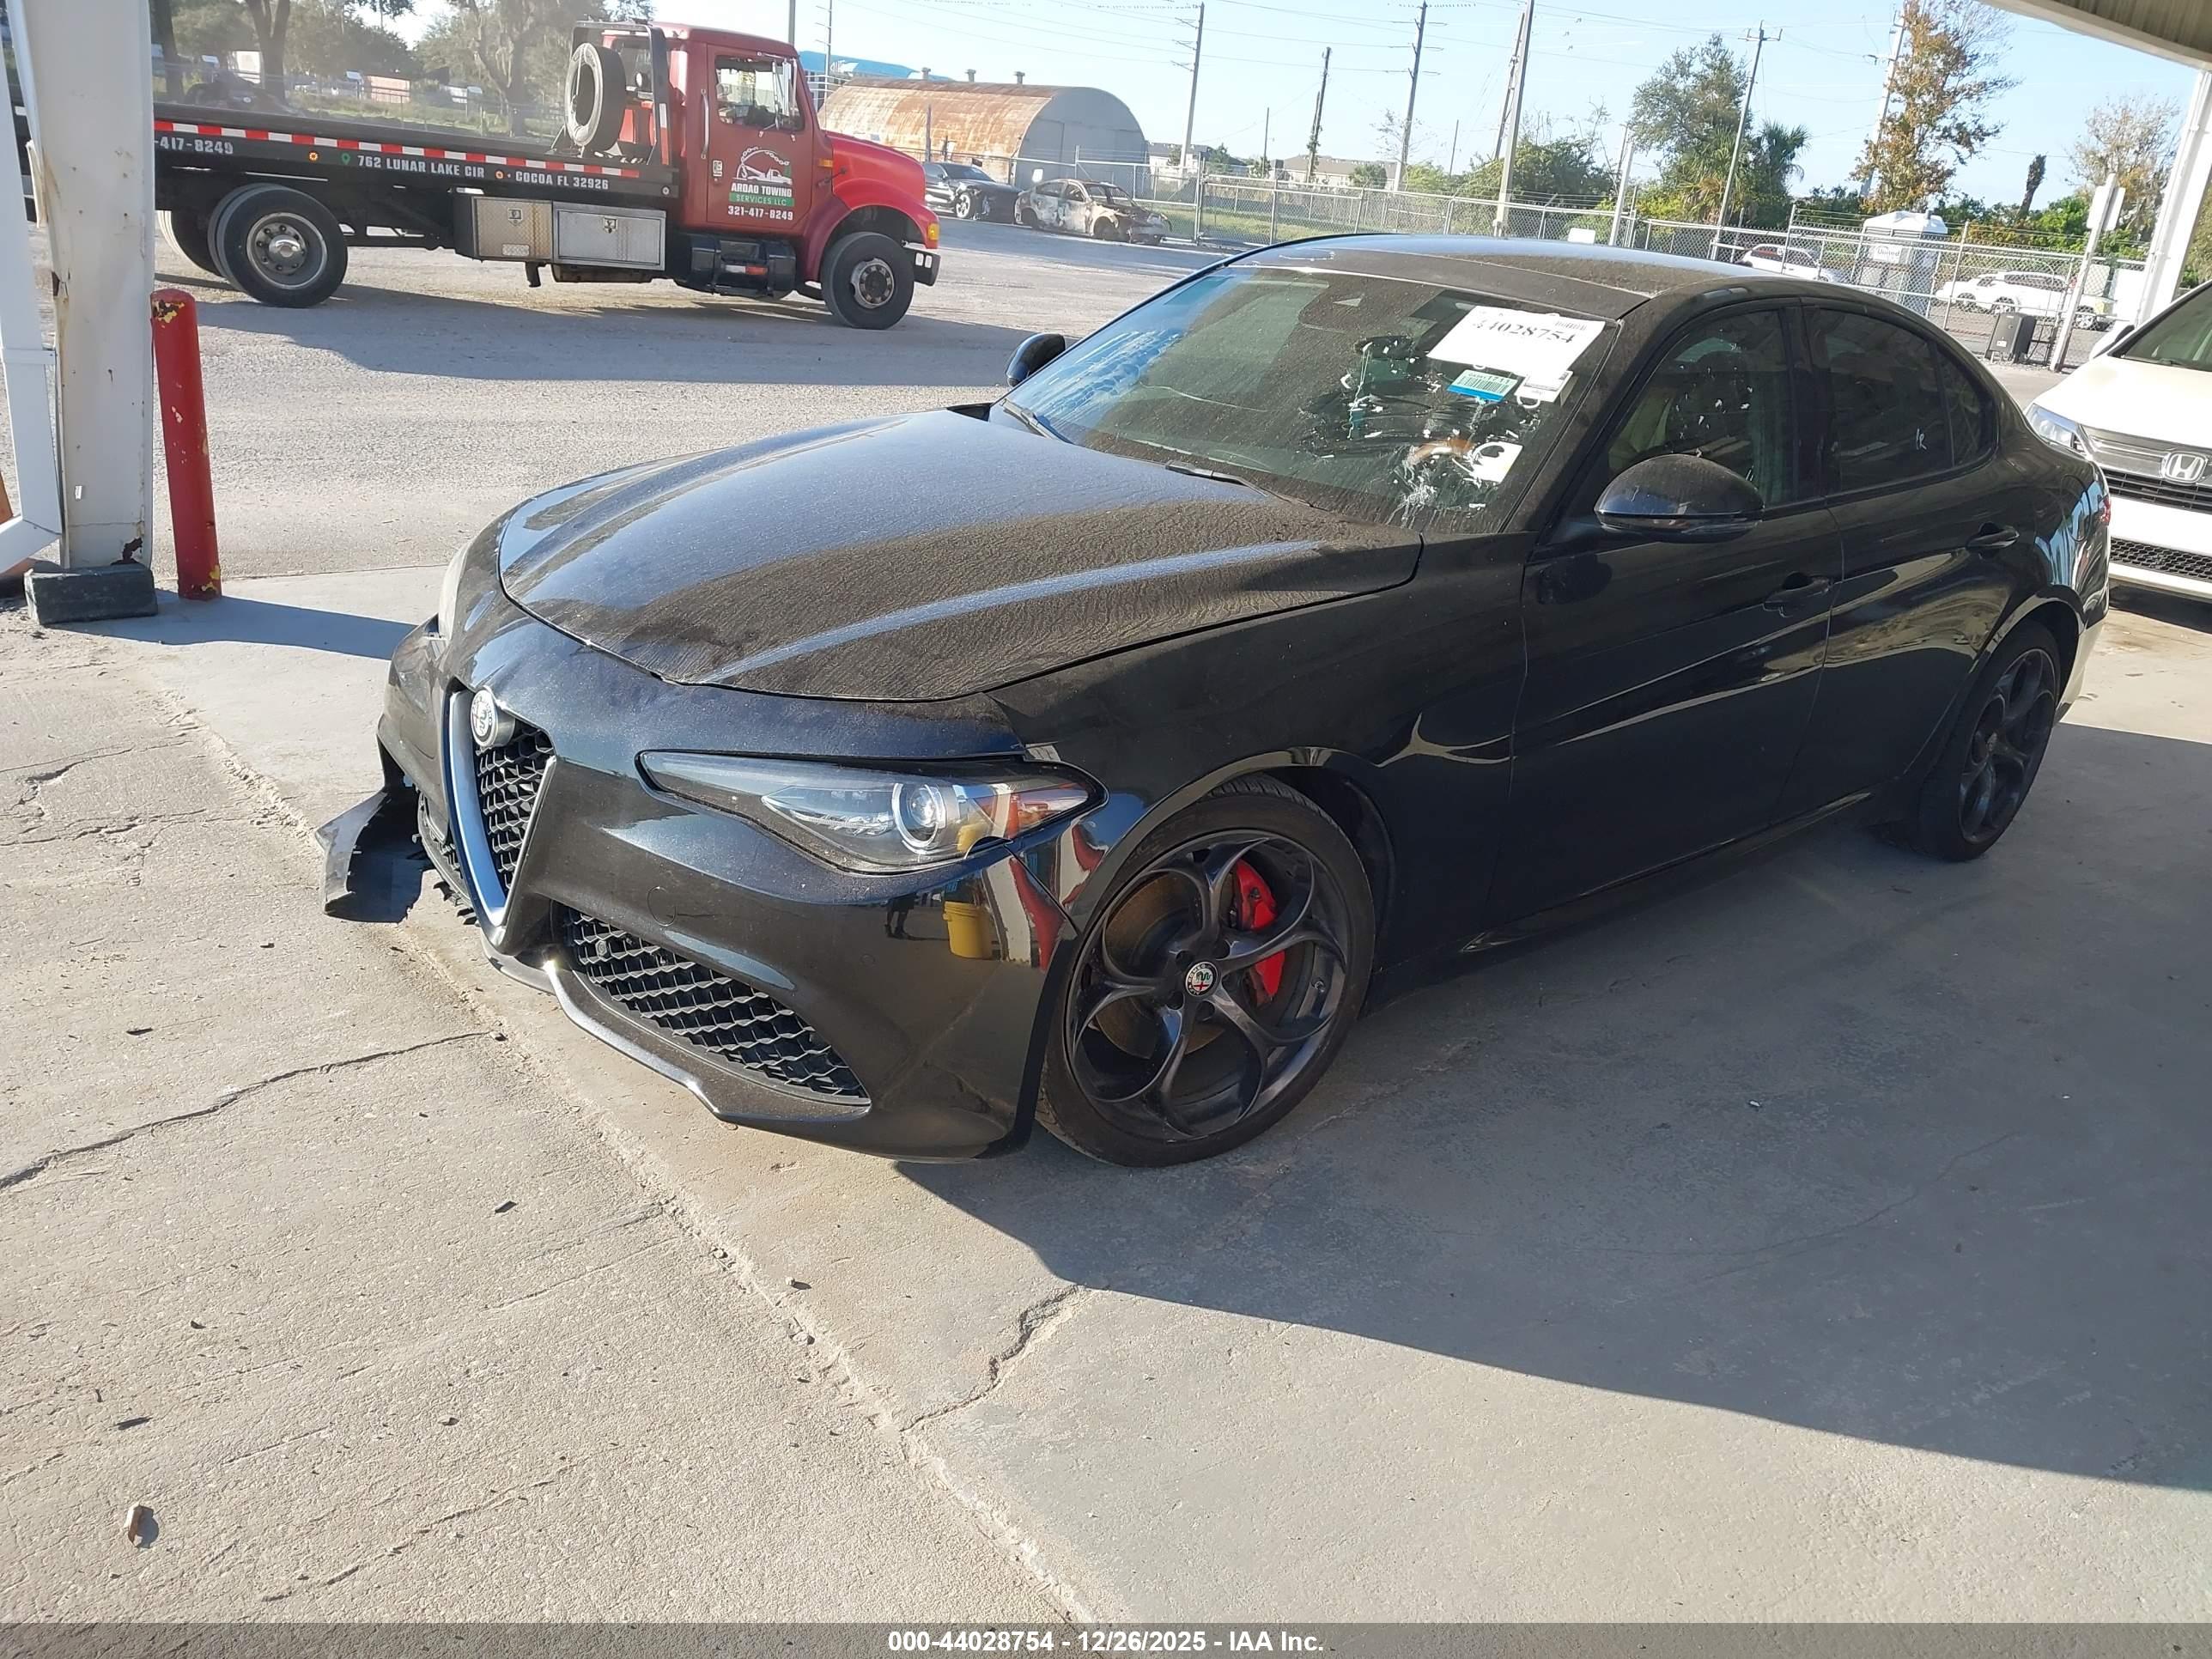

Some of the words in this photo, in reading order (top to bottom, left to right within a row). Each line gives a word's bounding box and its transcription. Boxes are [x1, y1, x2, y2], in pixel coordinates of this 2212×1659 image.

[357, 155, 382, 168] 762
[386, 157, 426, 173] LUNAR
[431, 162, 460, 176] LAKE
[465, 166, 485, 179] CIR
[515, 171, 553, 185] COCOA
[557, 175, 569, 187] FL
[574, 177, 609, 190] 32926
[762, 185, 792, 197] TOWING
[736, 194, 772, 204] SERVICES
[728, 206, 793, 220] 321-417-8249
